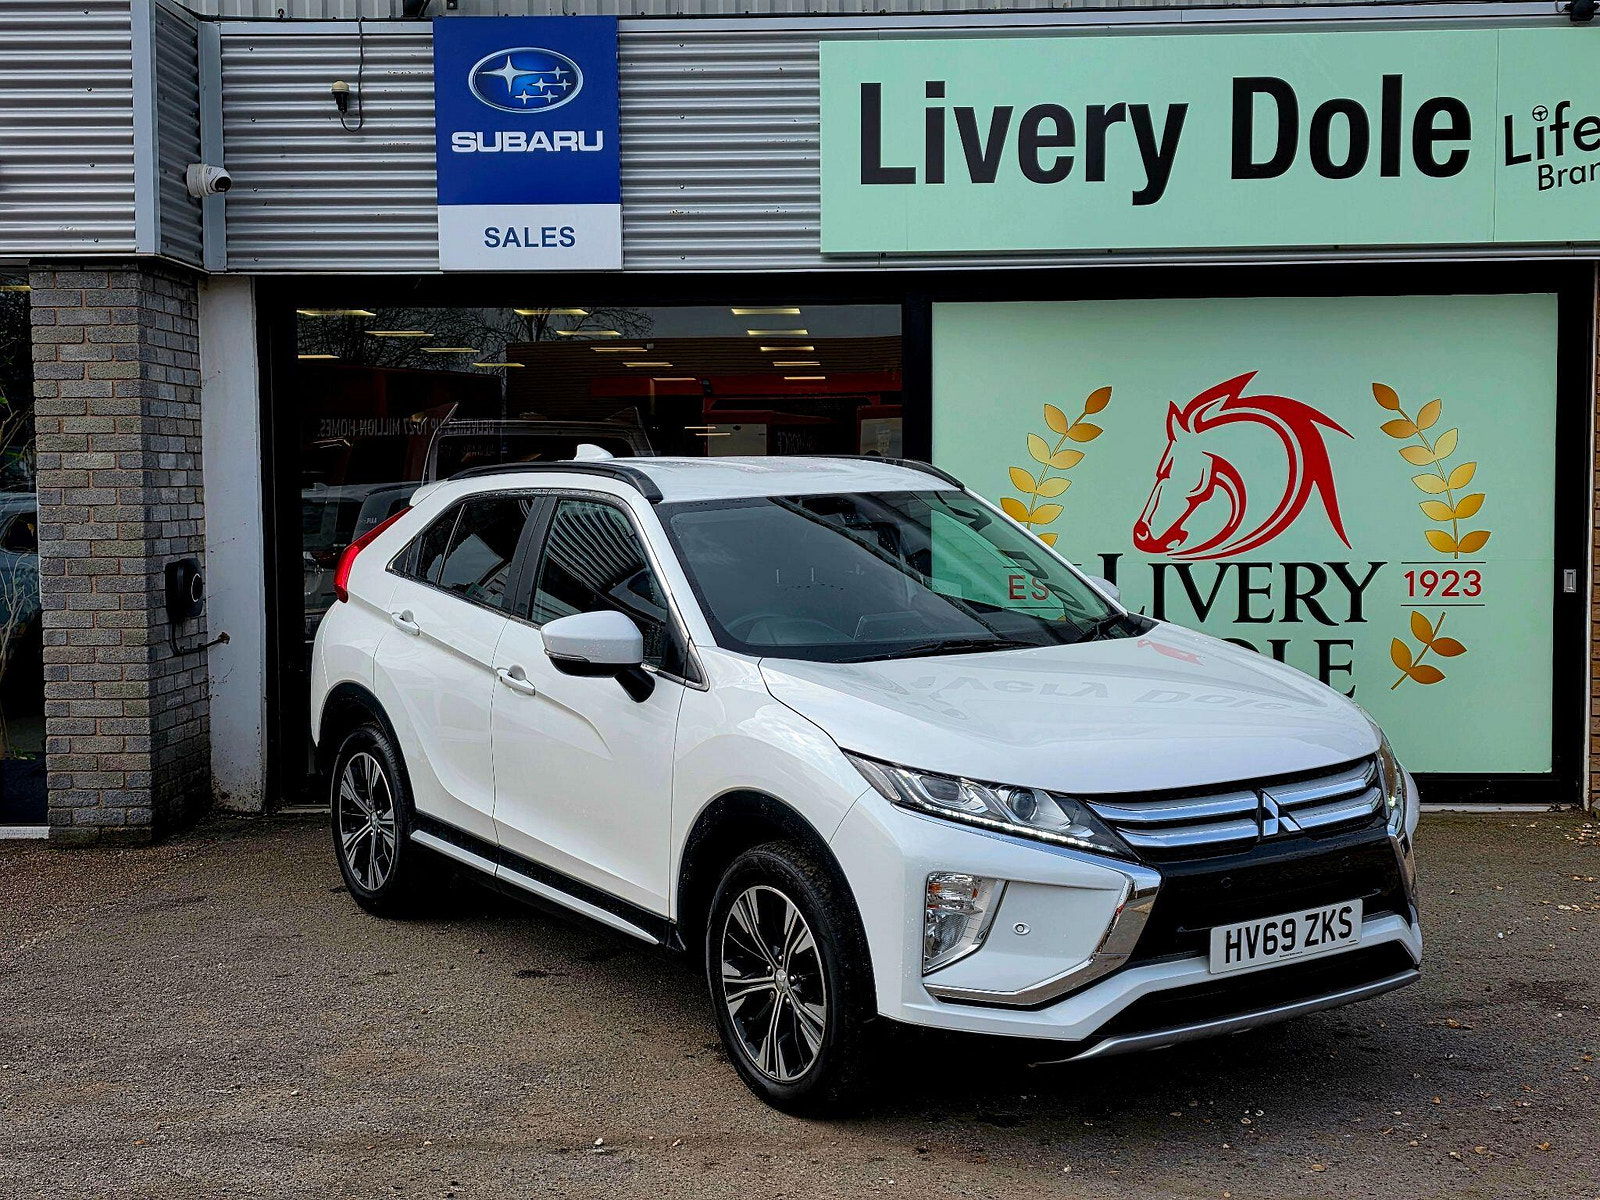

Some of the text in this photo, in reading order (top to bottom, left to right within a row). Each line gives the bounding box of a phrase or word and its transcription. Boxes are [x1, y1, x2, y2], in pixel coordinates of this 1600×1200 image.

[451, 130, 604, 153] SUBARU
[860, 73, 1472, 206] Livery Dole
[1503, 100, 1600, 167] Life
[484, 226, 576, 248] SALES
[1403, 569, 1482, 597] 1923
[1225, 906, 1353, 964] HV69 ZKS
